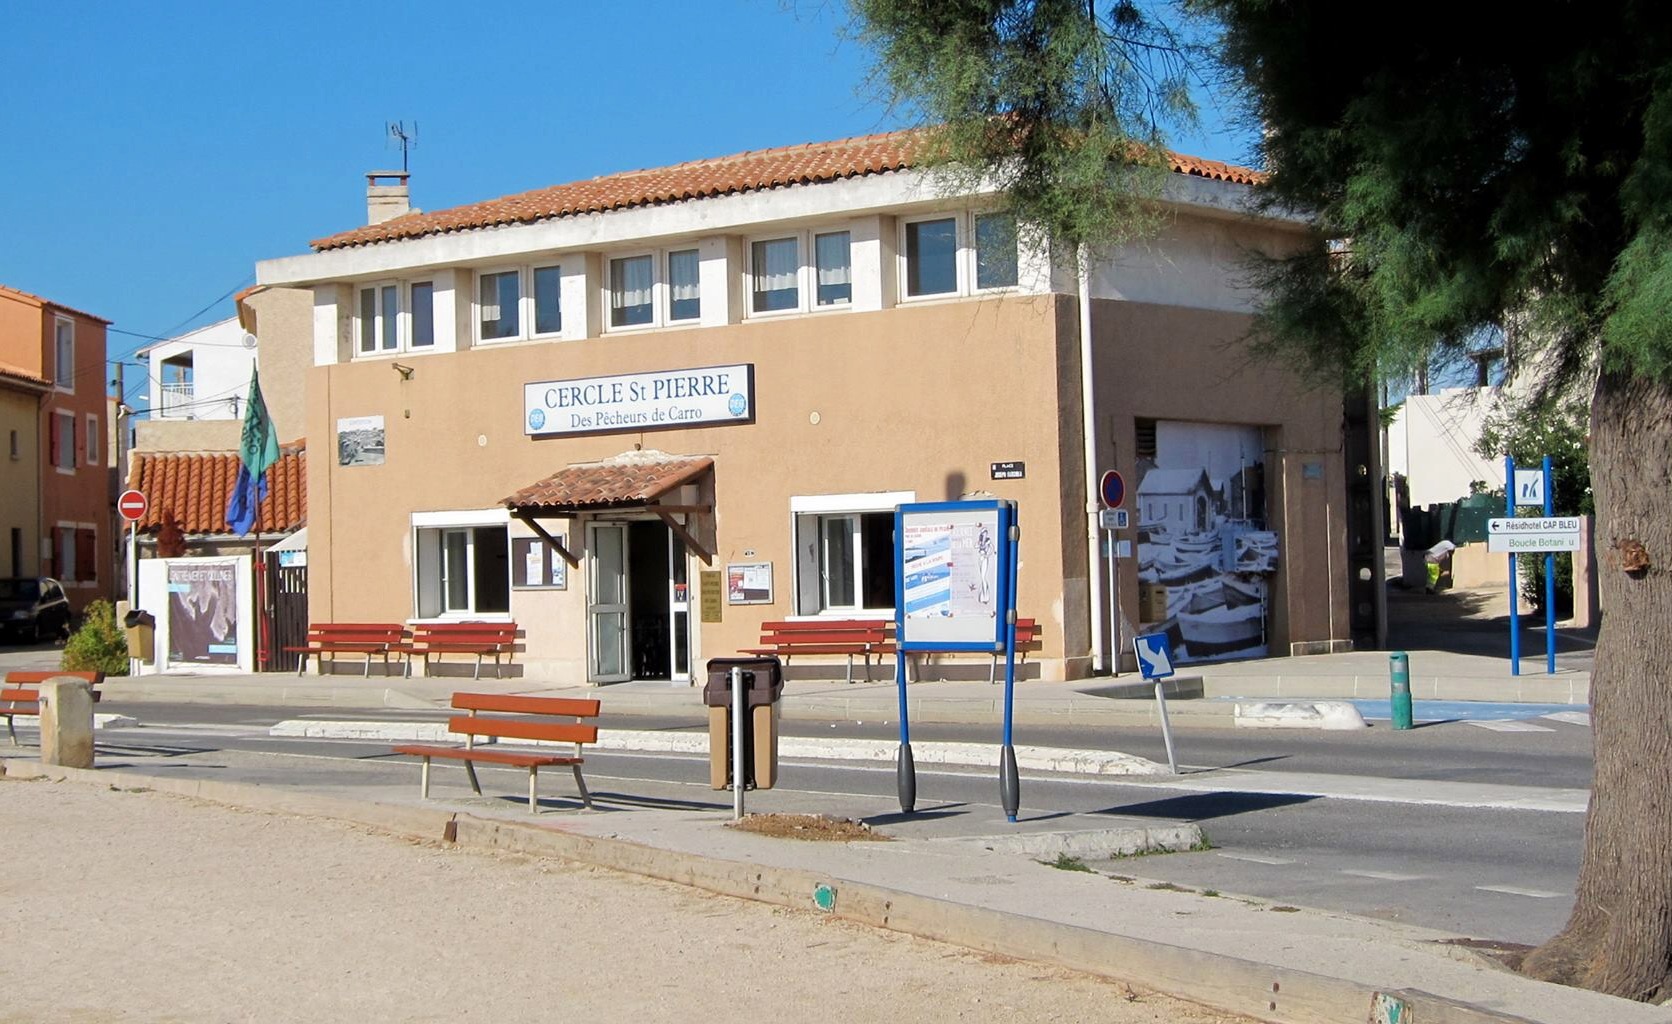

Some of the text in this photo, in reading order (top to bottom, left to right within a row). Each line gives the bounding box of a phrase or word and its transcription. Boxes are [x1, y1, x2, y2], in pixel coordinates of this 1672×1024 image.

[545, 373, 730, 409] CERCLE St PIERRE
[571, 405, 702, 428] Des Pêcheurs de Carro
[1542, 520, 1557, 530] CAP
[1558, 520, 1577, 529] BLEU
[1508, 538, 1537, 548] Boucle
